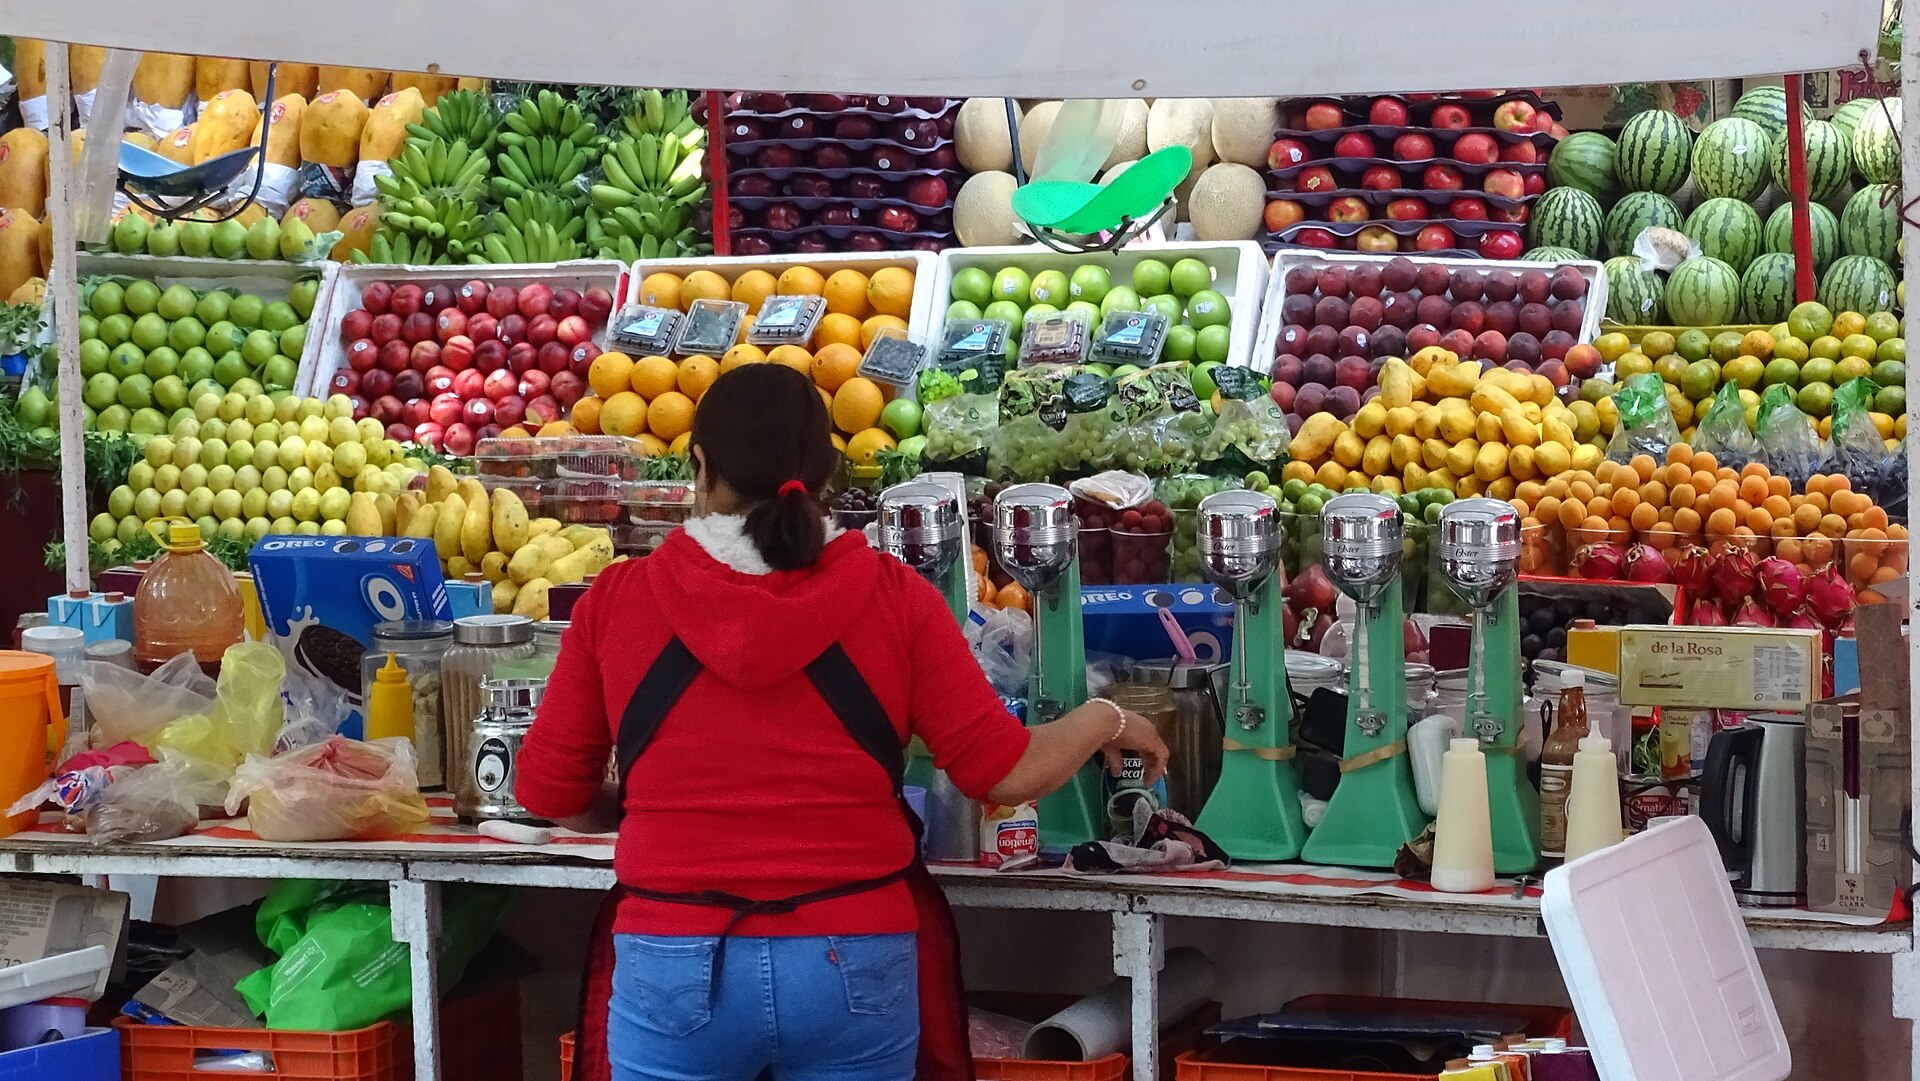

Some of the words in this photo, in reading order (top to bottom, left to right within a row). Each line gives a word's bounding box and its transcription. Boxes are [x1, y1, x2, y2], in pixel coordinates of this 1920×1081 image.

[262, 540, 326, 551] OREO
[1213, 542, 1236, 551] Oster
[1336, 545, 1360, 554] Oster
[1455, 548, 1480, 558] Oster
[1651, 641, 1669, 654] de
[1671, 642, 1684, 654] la
[1687, 642, 1723, 655] Rosa
[1123, 759, 1144, 768] SCAF
[1122, 767, 1146, 780] ecaf
[1630, 799, 1672, 815] Crnation
[1818, 837, 1828, 850] 4
[1839, 894, 1865, 902] SANTA
